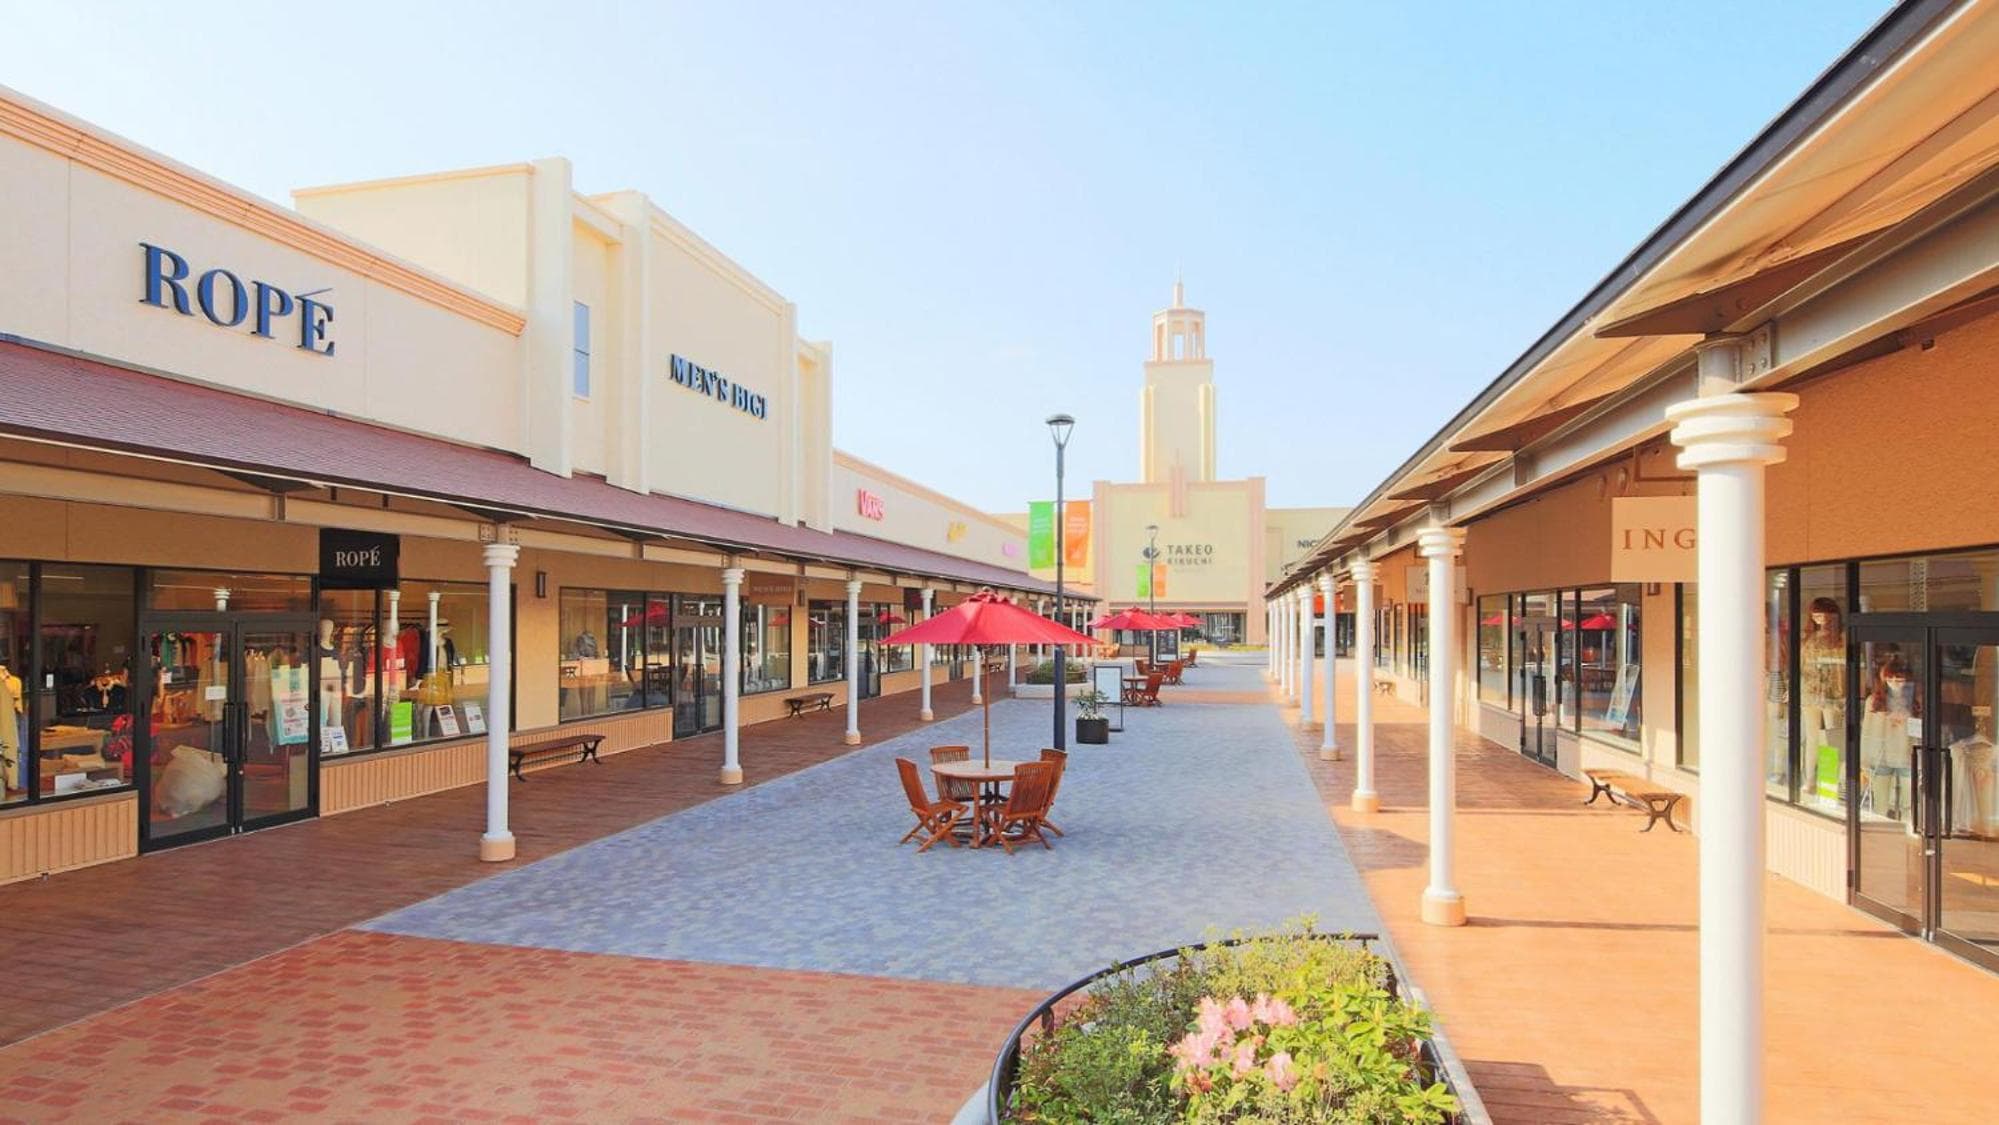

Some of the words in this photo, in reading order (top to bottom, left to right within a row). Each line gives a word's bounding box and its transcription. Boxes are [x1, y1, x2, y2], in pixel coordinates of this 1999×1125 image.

[138, 242, 335, 357] ROPÉ
[670, 353, 728, 401] MEN'S
[732, 383, 768, 420] BIGI
[858, 488, 885, 521] VANS
[1167, 544, 1213, 555] TAKEO
[1622, 528, 1696, 550] ING
[335, 545, 381, 567] ROPÉ
